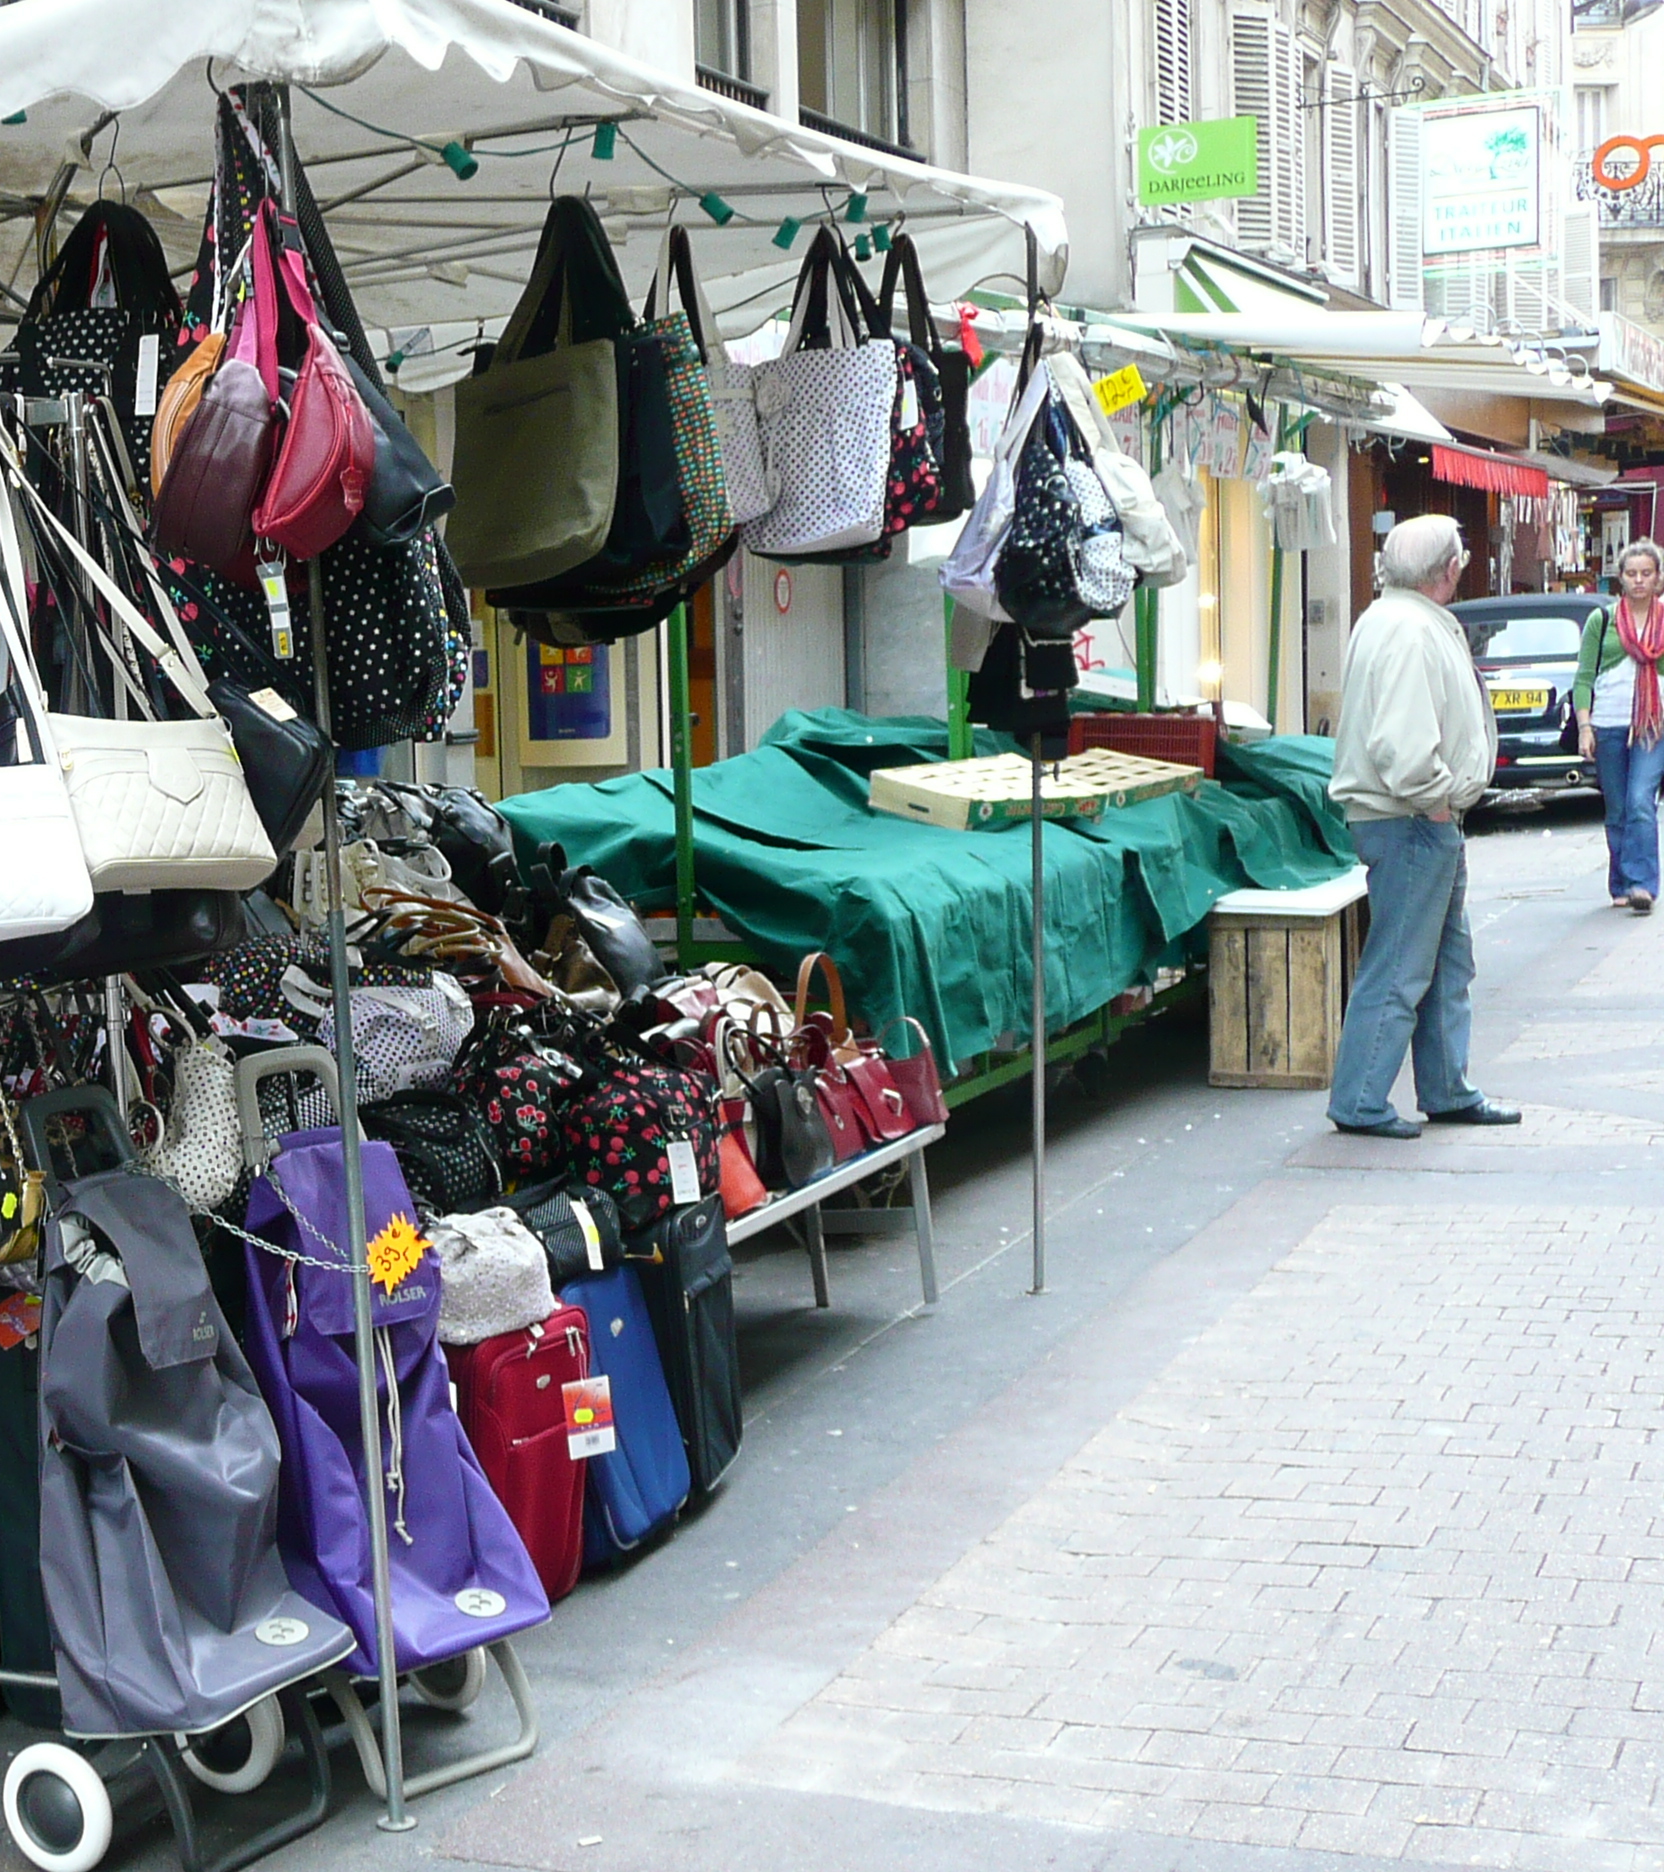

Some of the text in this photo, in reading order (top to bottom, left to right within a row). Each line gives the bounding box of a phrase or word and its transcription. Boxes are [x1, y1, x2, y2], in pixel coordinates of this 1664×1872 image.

[1433, 197, 1528, 221] TRAITEUR
[1440, 221, 1521, 242] ITALIEN
[1505, 691, 1521, 706] XR
[1526, 691, 1543, 704] 94
[378, 1285, 427, 1308] ROLSER
